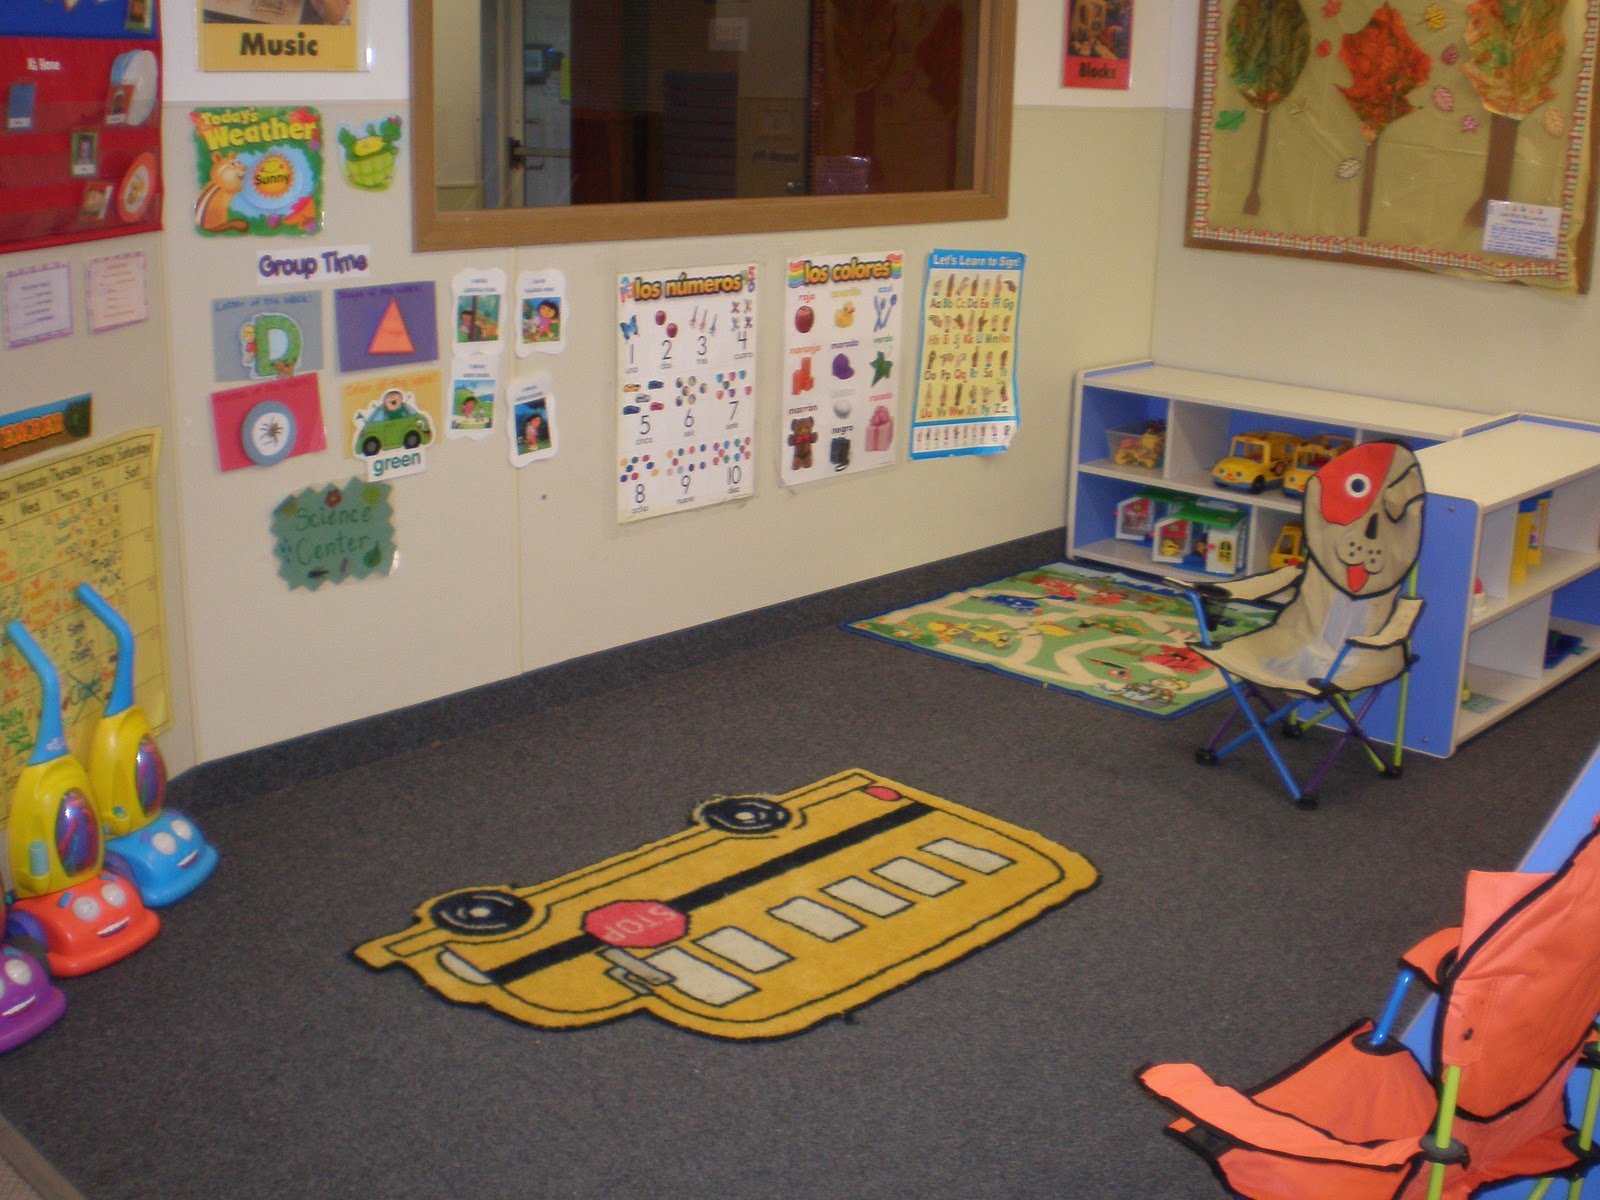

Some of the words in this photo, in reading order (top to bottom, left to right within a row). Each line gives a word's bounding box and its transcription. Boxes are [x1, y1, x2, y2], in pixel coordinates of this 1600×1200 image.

[240, 31, 318, 56] Music
[200, 107, 259, 125] Today's
[203, 117, 316, 150] Weather
[254, 173, 291, 187] Sunny
[259, 254, 318, 279] Group
[321, 250, 368, 274] Time
[804, 260, 829, 285] los
[831, 256, 891, 283] colores
[933, 255, 957, 265] Let's
[960, 255, 986, 266] Learn
[988, 257, 997, 266] to
[634, 276, 662, 301] los
[665, 271, 743, 299] números
[255, 314, 302, 377] D
[662, 340, 673, 360] 2
[697, 336, 708, 356] 3
[737, 331, 748, 350] 4
[684, 408, 695, 428] 6
[729, 400, 739, 420] 7
[639, 415, 651, 435] 5
[373, 453, 421, 477] green
[681, 475, 692, 494] 9
[727, 466, 741, 485] 10
[635, 484, 646, 503] 8
[296, 507, 371, 532] Science
[298, 530, 369, 566] Center
[603, 904, 678, 941] STOP
